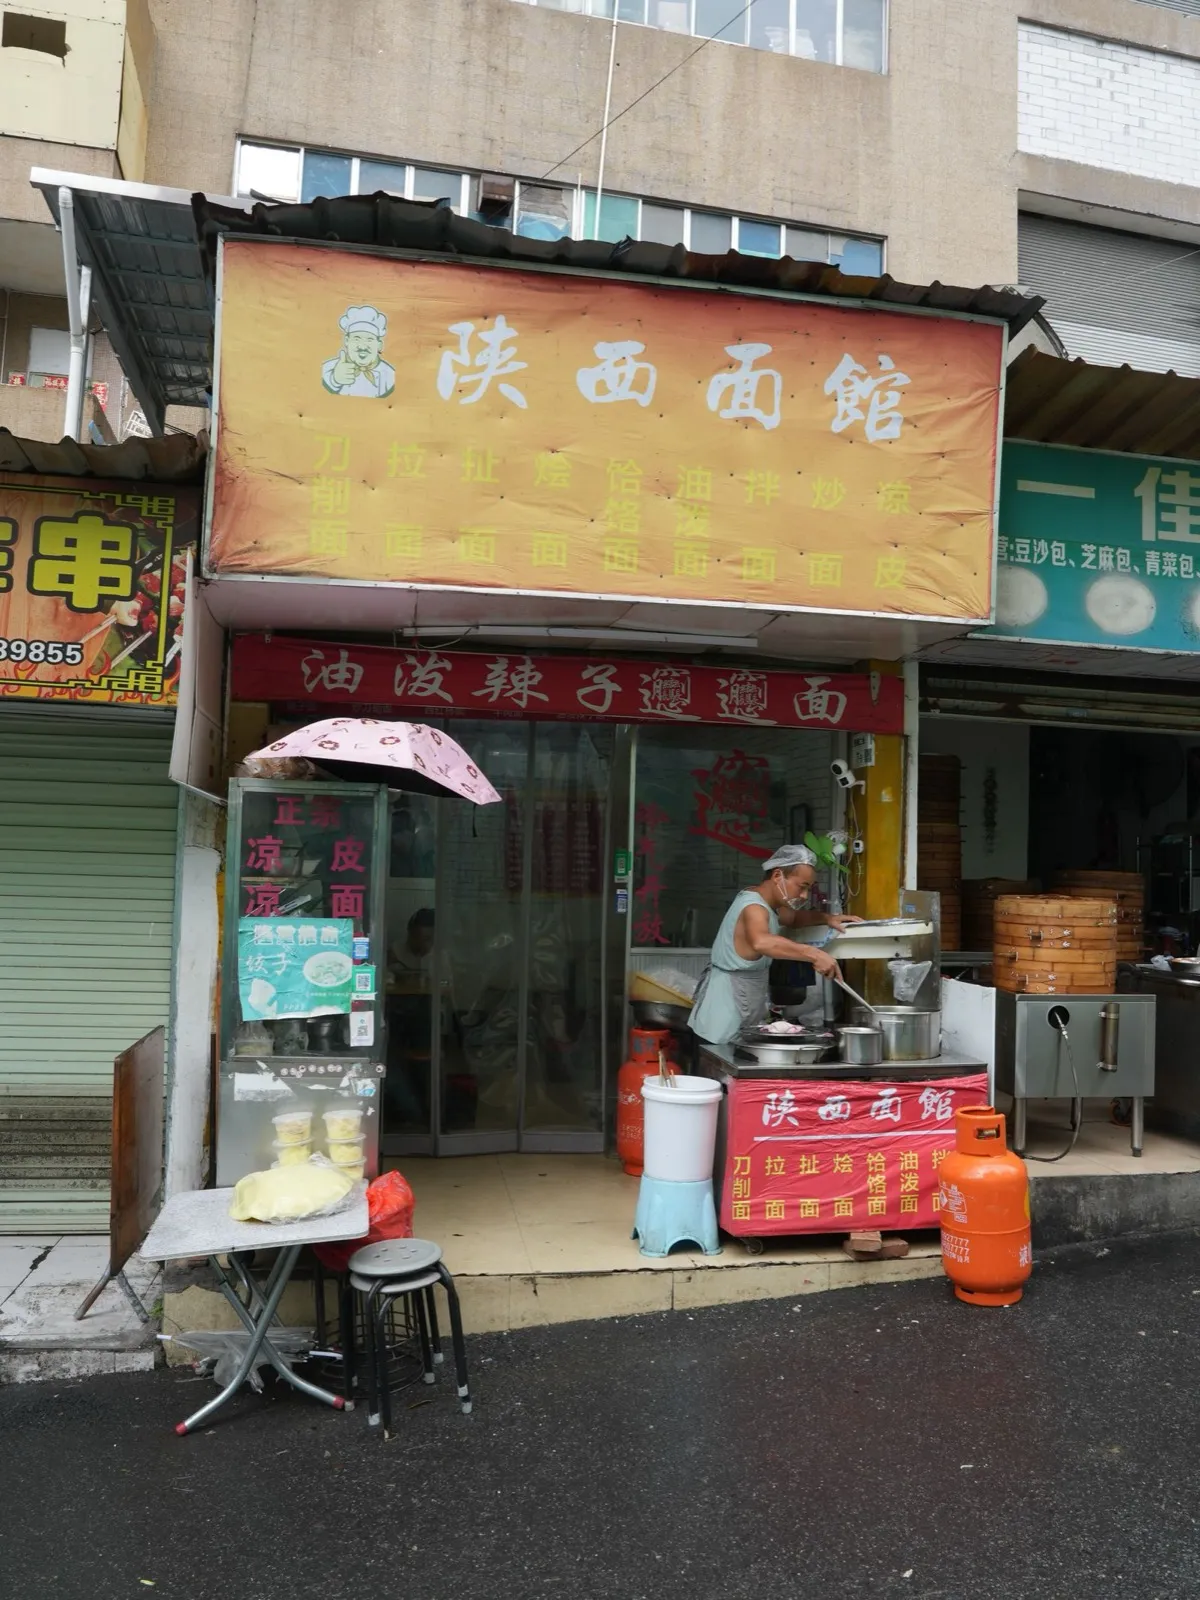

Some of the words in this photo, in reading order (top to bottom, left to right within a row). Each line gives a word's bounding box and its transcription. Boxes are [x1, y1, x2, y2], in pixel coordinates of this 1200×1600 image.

[308, 435, 350, 557] 刀削面
[385, 441, 427, 560] 拉面
[458, 446, 499, 564] 扯面
[532, 451, 572, 568] 烩面
[673, 464, 712, 579] 油泼面
[741, 469, 780, 583] 拌面
[808, 476, 846, 588] 炒面
[872, 481, 912, 589] 凉皮
[274, 796, 342, 827] 正宗
[246, 835, 366, 872] 凉皮
[245, 884, 366, 918] 凉面
[731, 1156, 751, 1221] 刀削面
[765, 1155, 786, 1220] 拉面
[799, 1154, 820, 1218] 扯面
[833, 1154, 853, 1217] 烩面
[866, 1152, 887, 1217] 饸饹面
[899, 1151, 919, 1213] 油泼面
